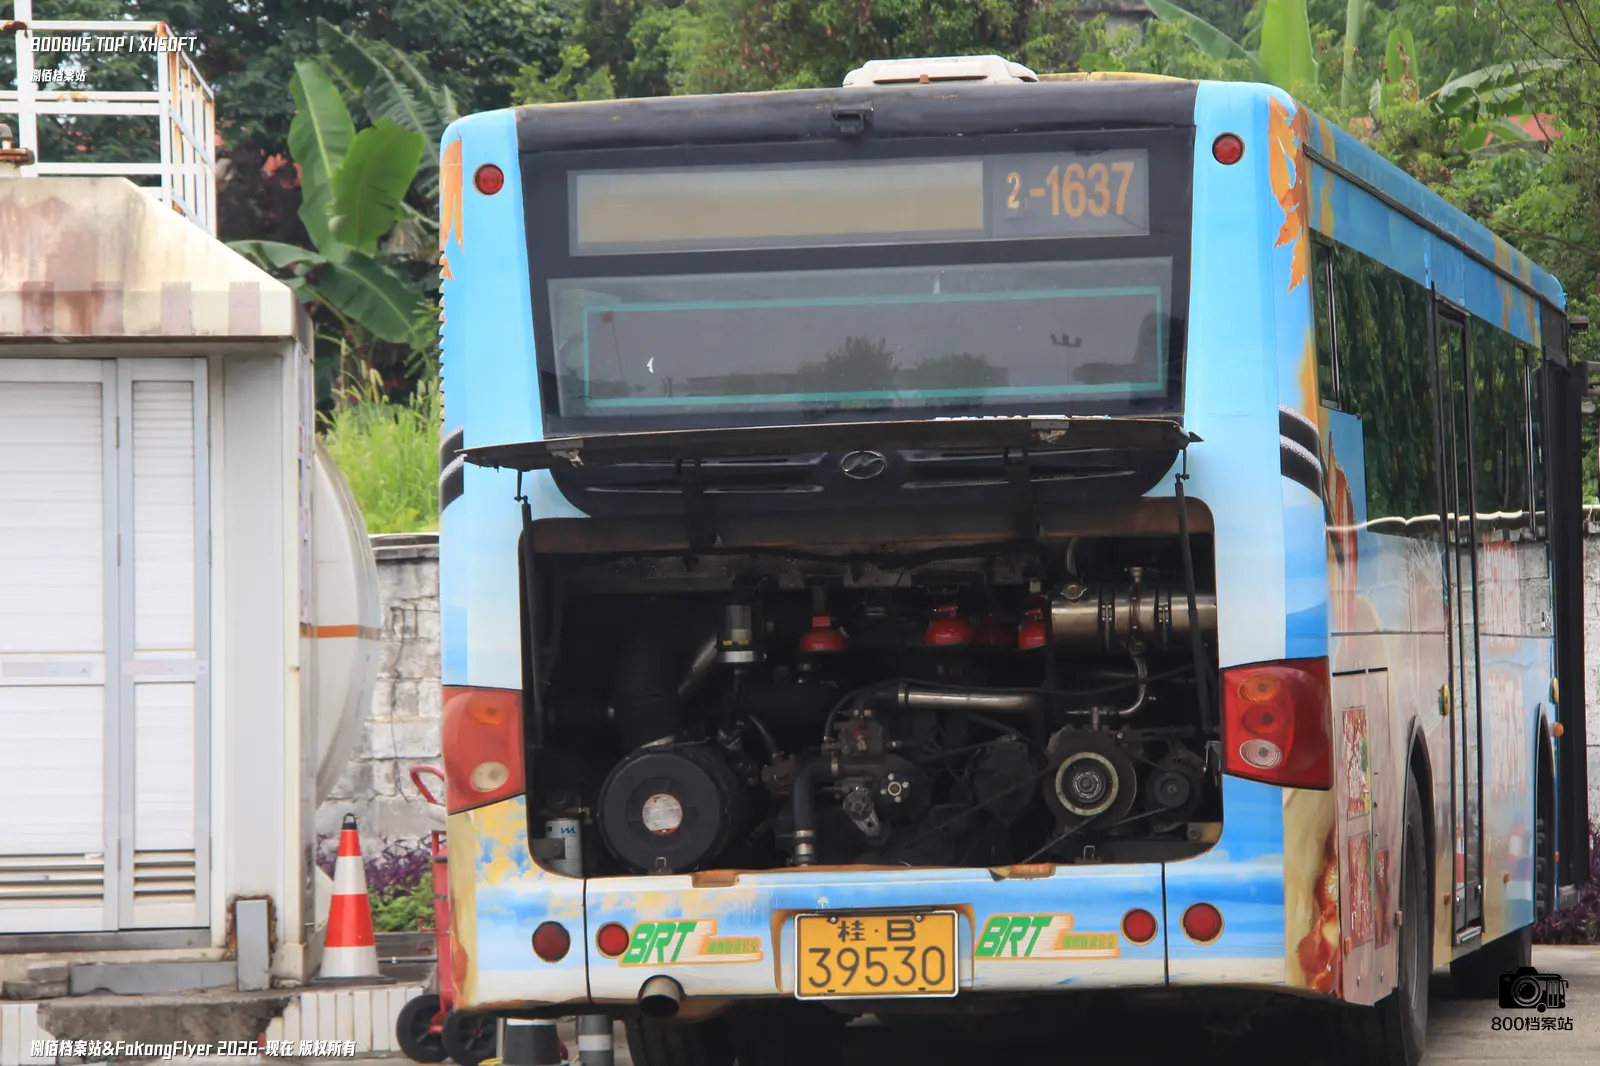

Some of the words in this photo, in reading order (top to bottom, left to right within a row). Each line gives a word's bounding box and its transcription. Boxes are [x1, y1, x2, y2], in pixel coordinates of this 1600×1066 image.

[622, 921, 698, 964] BRT
[974, 916, 1054, 957] BRT
[808, 946, 945, 987] 39530
